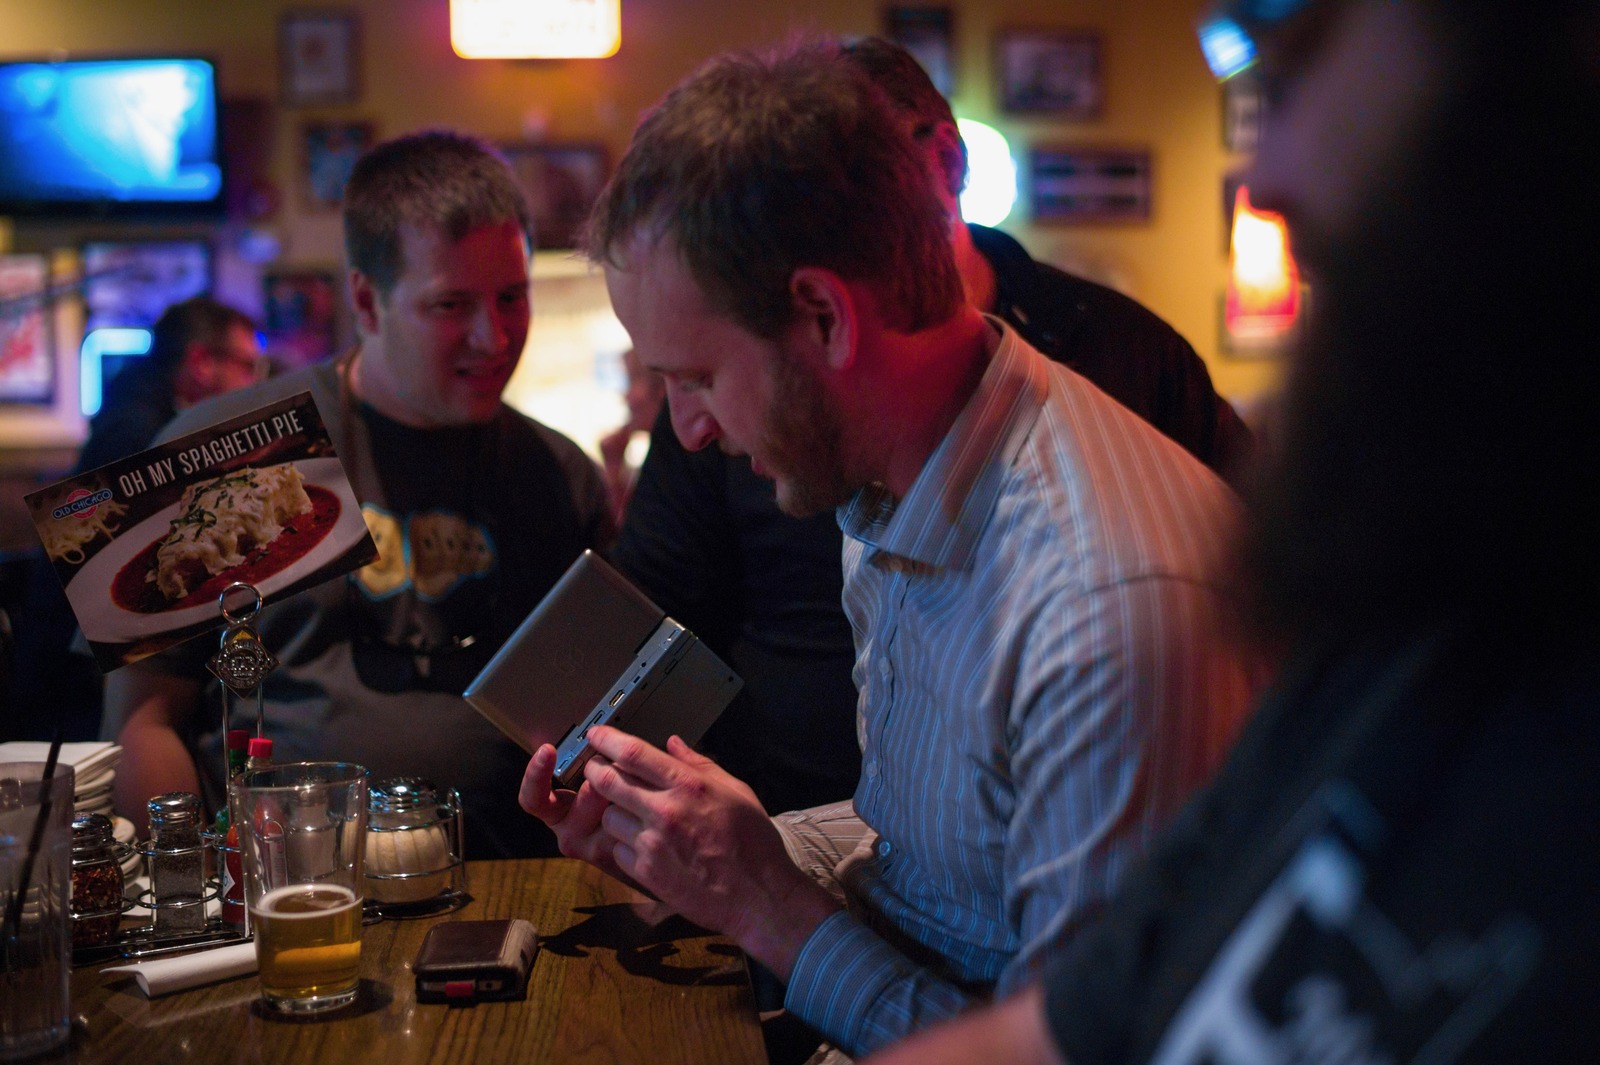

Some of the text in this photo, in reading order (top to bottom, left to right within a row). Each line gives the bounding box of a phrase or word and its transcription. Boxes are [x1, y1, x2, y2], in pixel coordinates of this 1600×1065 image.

[119, 409, 304, 497] OH MY SPAGHETTI PIE
[53, 490, 111, 518] OLD CHICAGO
